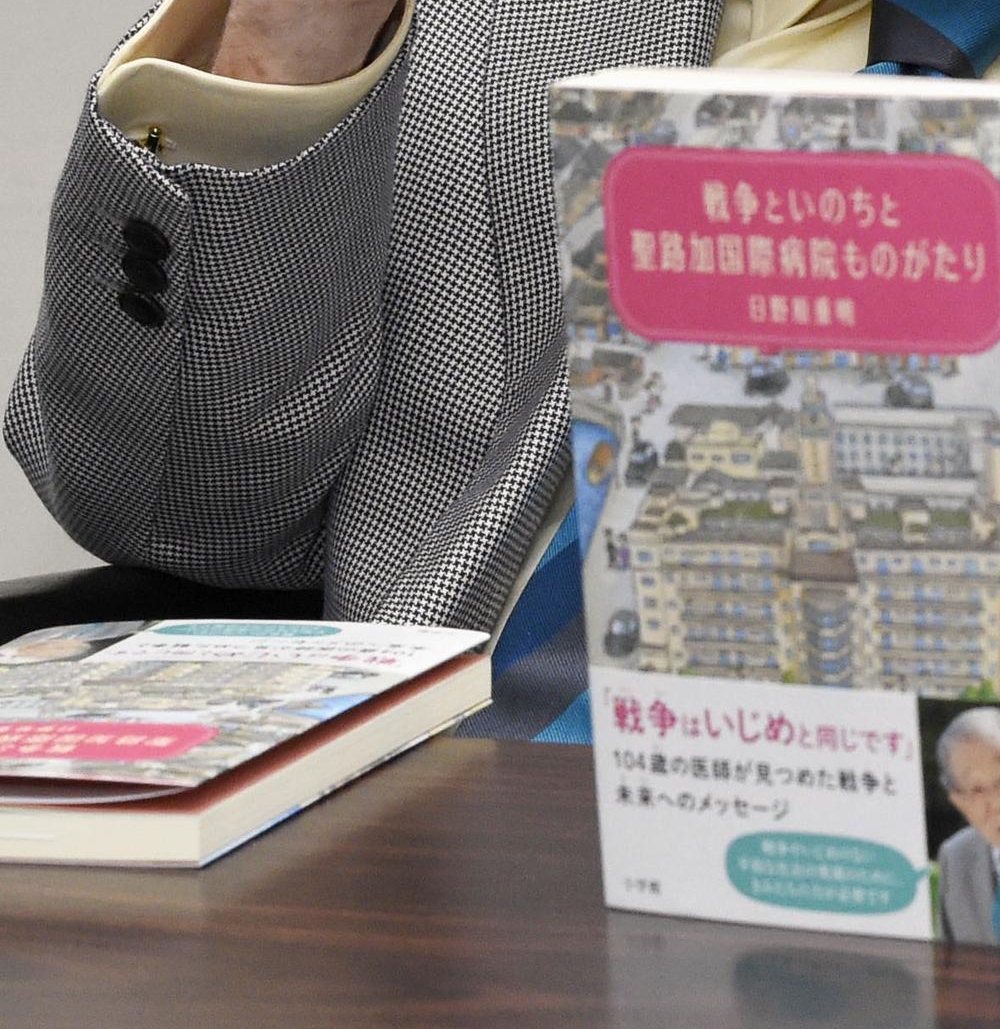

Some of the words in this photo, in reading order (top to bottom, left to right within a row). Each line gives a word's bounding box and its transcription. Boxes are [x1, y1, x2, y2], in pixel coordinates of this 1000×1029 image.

[703, 179, 900, 228] 戦争といのちと
